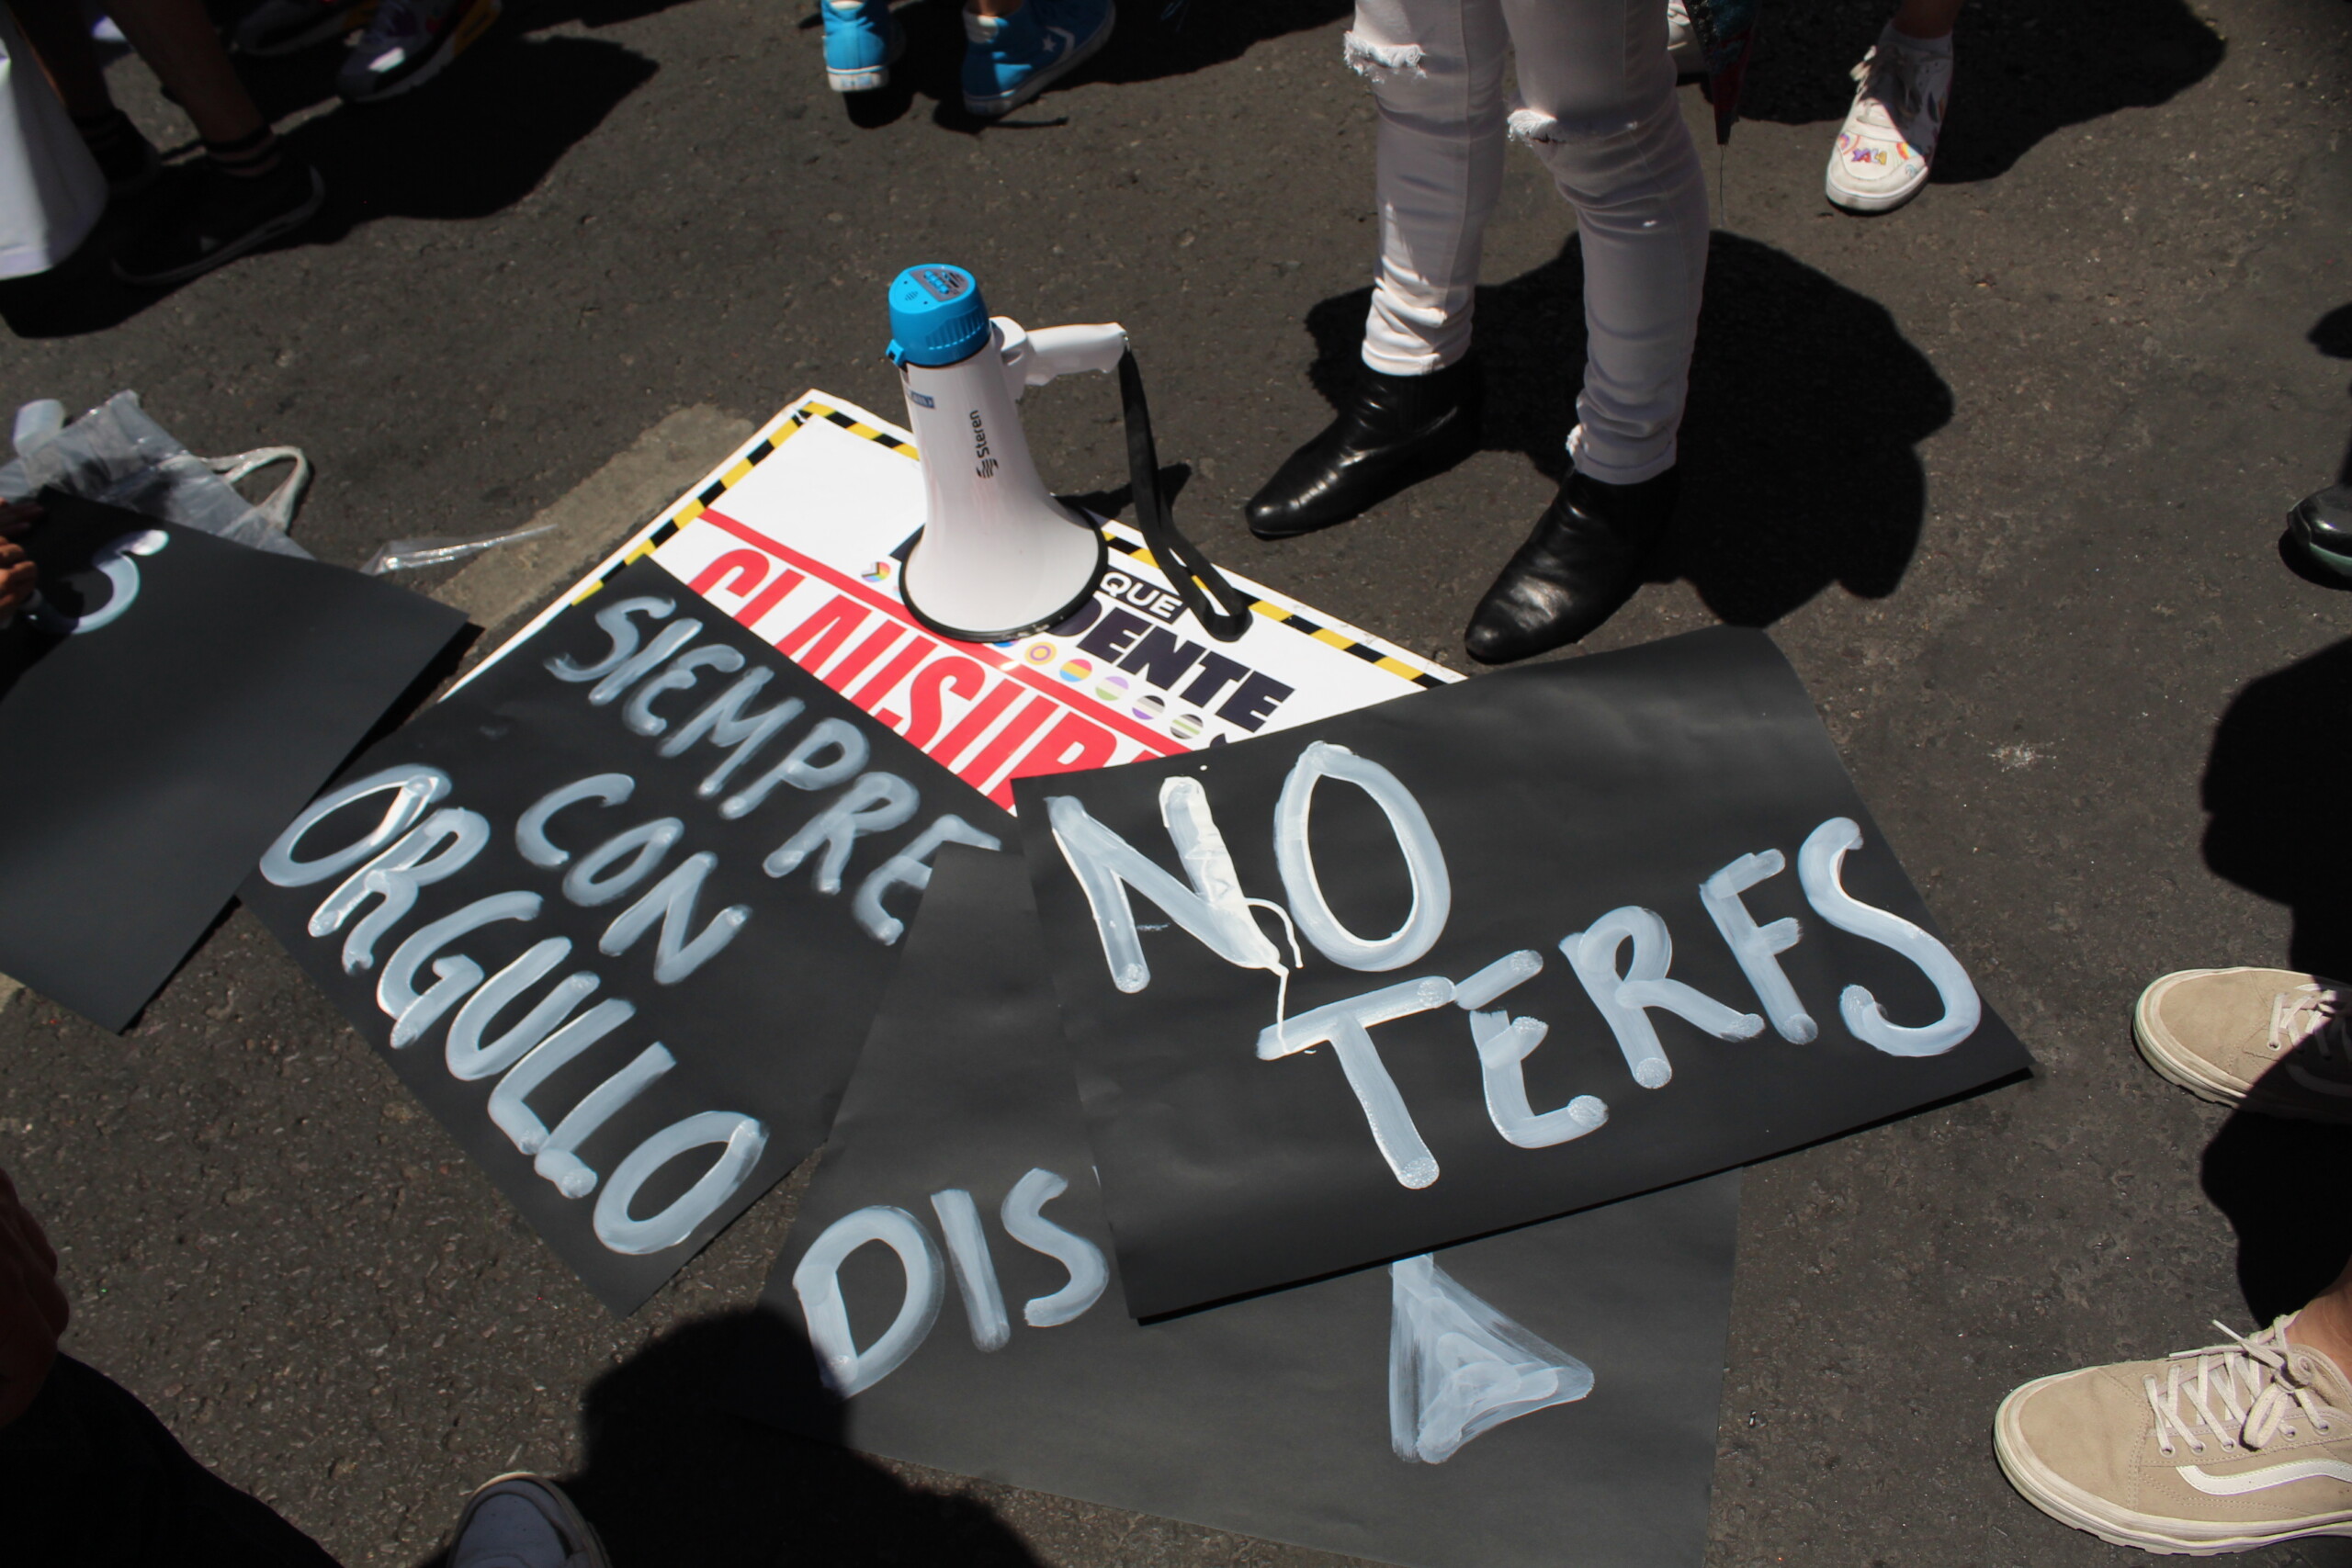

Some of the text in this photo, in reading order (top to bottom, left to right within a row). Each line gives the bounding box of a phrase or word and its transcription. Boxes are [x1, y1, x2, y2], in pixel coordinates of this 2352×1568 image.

[968, 410, 990, 457] Steren
[1045, 595, 1295, 733] DENTE
[1100, 572, 1182, 619] QUE
[515, 773, 752, 985] CON
[544, 595, 1001, 946] SIEMPRE
[1046, 740, 1453, 994] NO
[259, 763, 770, 1255] ORGULLO
[1256, 817, 1982, 1191] TERFS
[792, 1168, 1110, 1399] DIS
